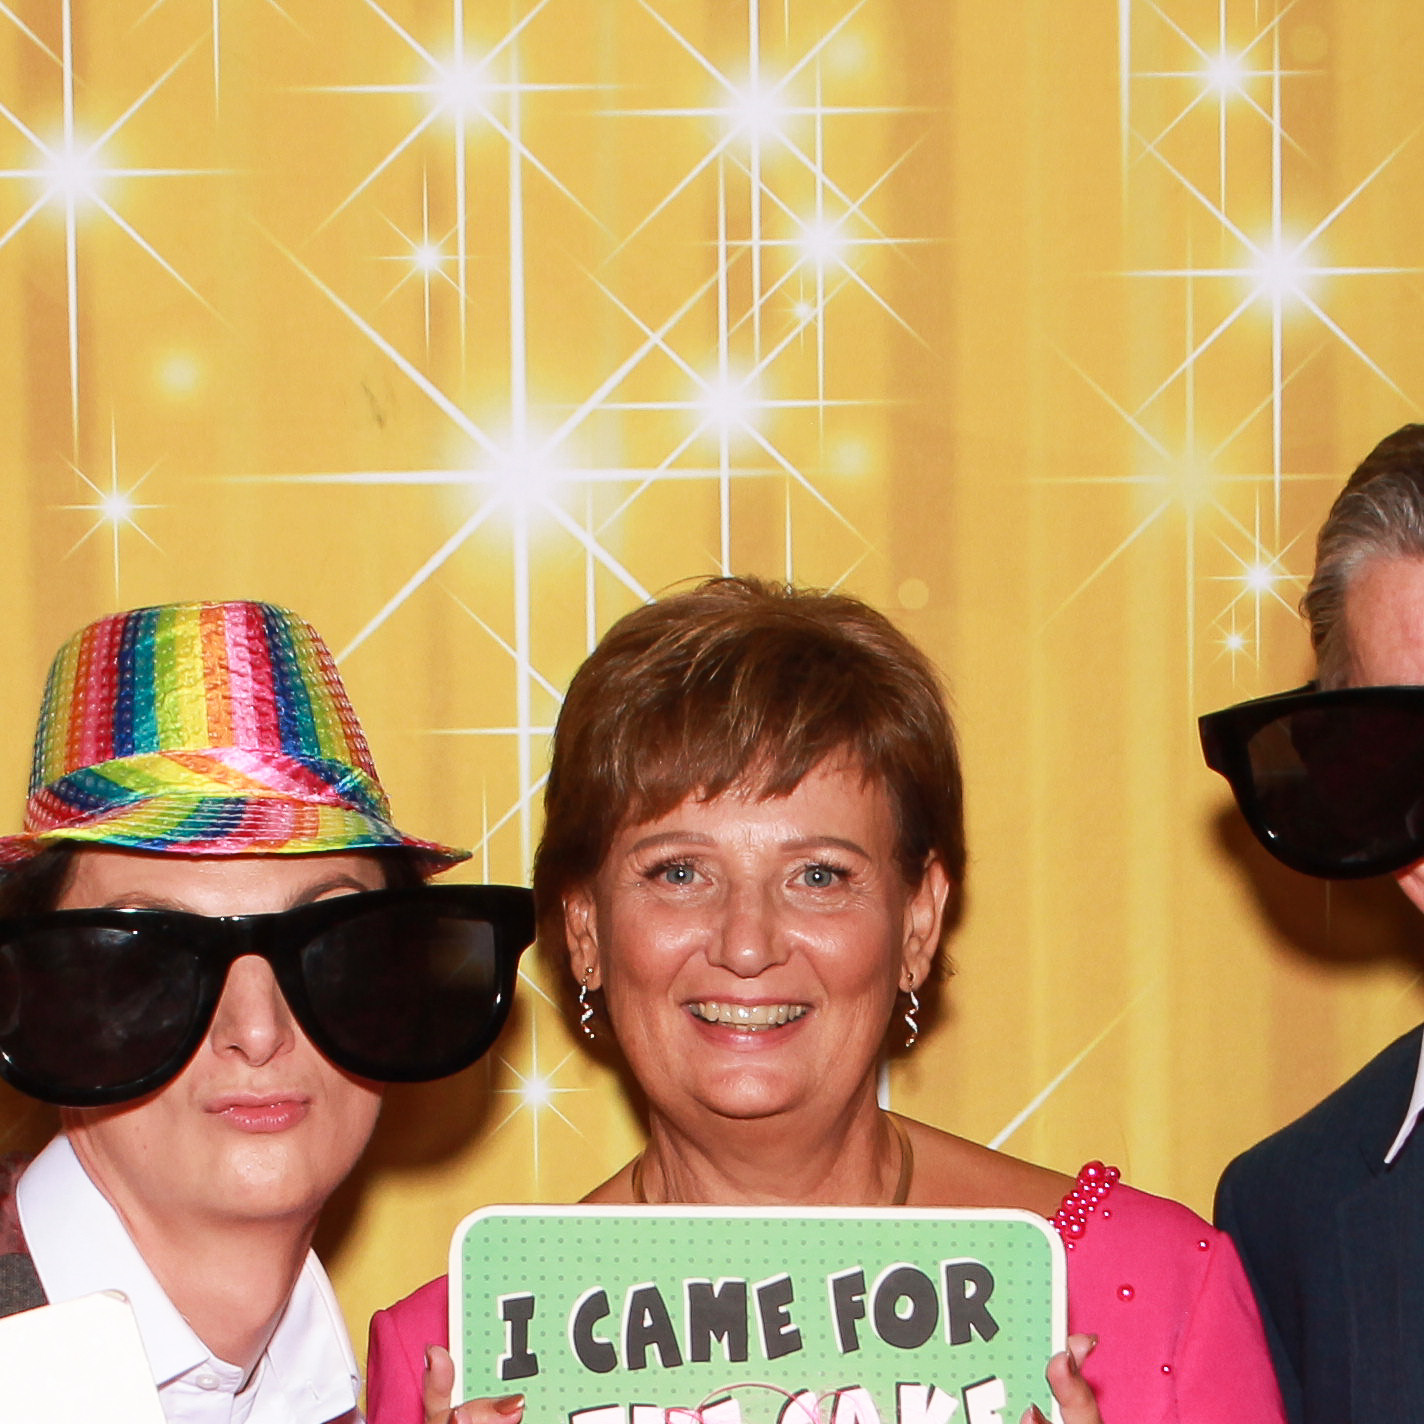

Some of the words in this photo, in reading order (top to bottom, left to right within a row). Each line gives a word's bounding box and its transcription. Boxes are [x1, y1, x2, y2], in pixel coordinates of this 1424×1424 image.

[498, 1291, 539, 1380] I
[571, 1275, 803, 1373] CAME
[828, 1258, 999, 1353] FOR
